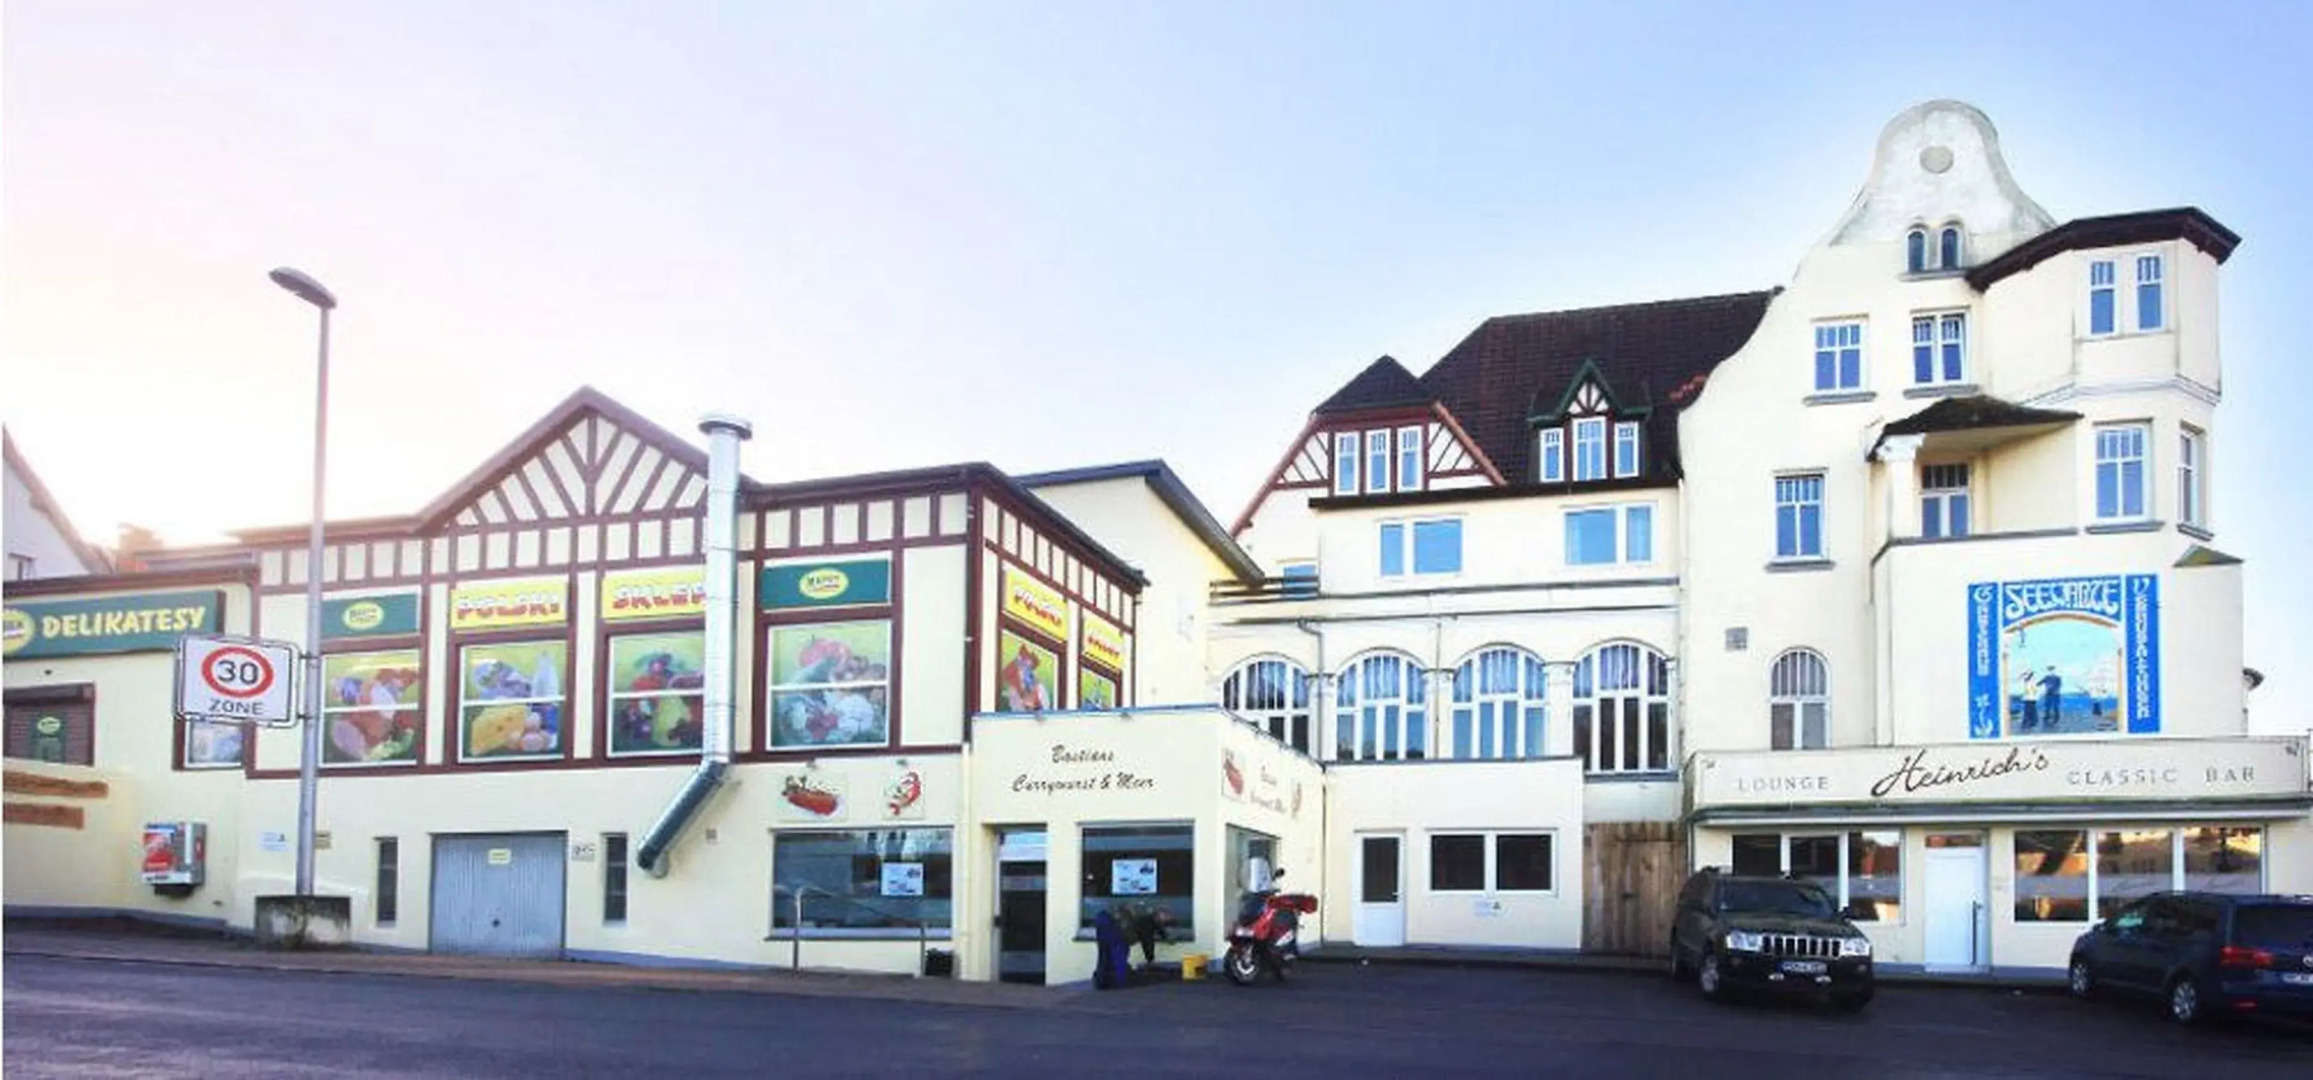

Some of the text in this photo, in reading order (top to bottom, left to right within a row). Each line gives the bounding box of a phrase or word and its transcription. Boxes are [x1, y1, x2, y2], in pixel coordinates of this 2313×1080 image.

[41, 606, 206, 638] DELIKATESY
[218, 659, 259, 685] 30
[208, 698, 264, 715] ZONE
[1737, 747, 2256, 797] LOUNGE Heinrich's CLASSIC BAR
